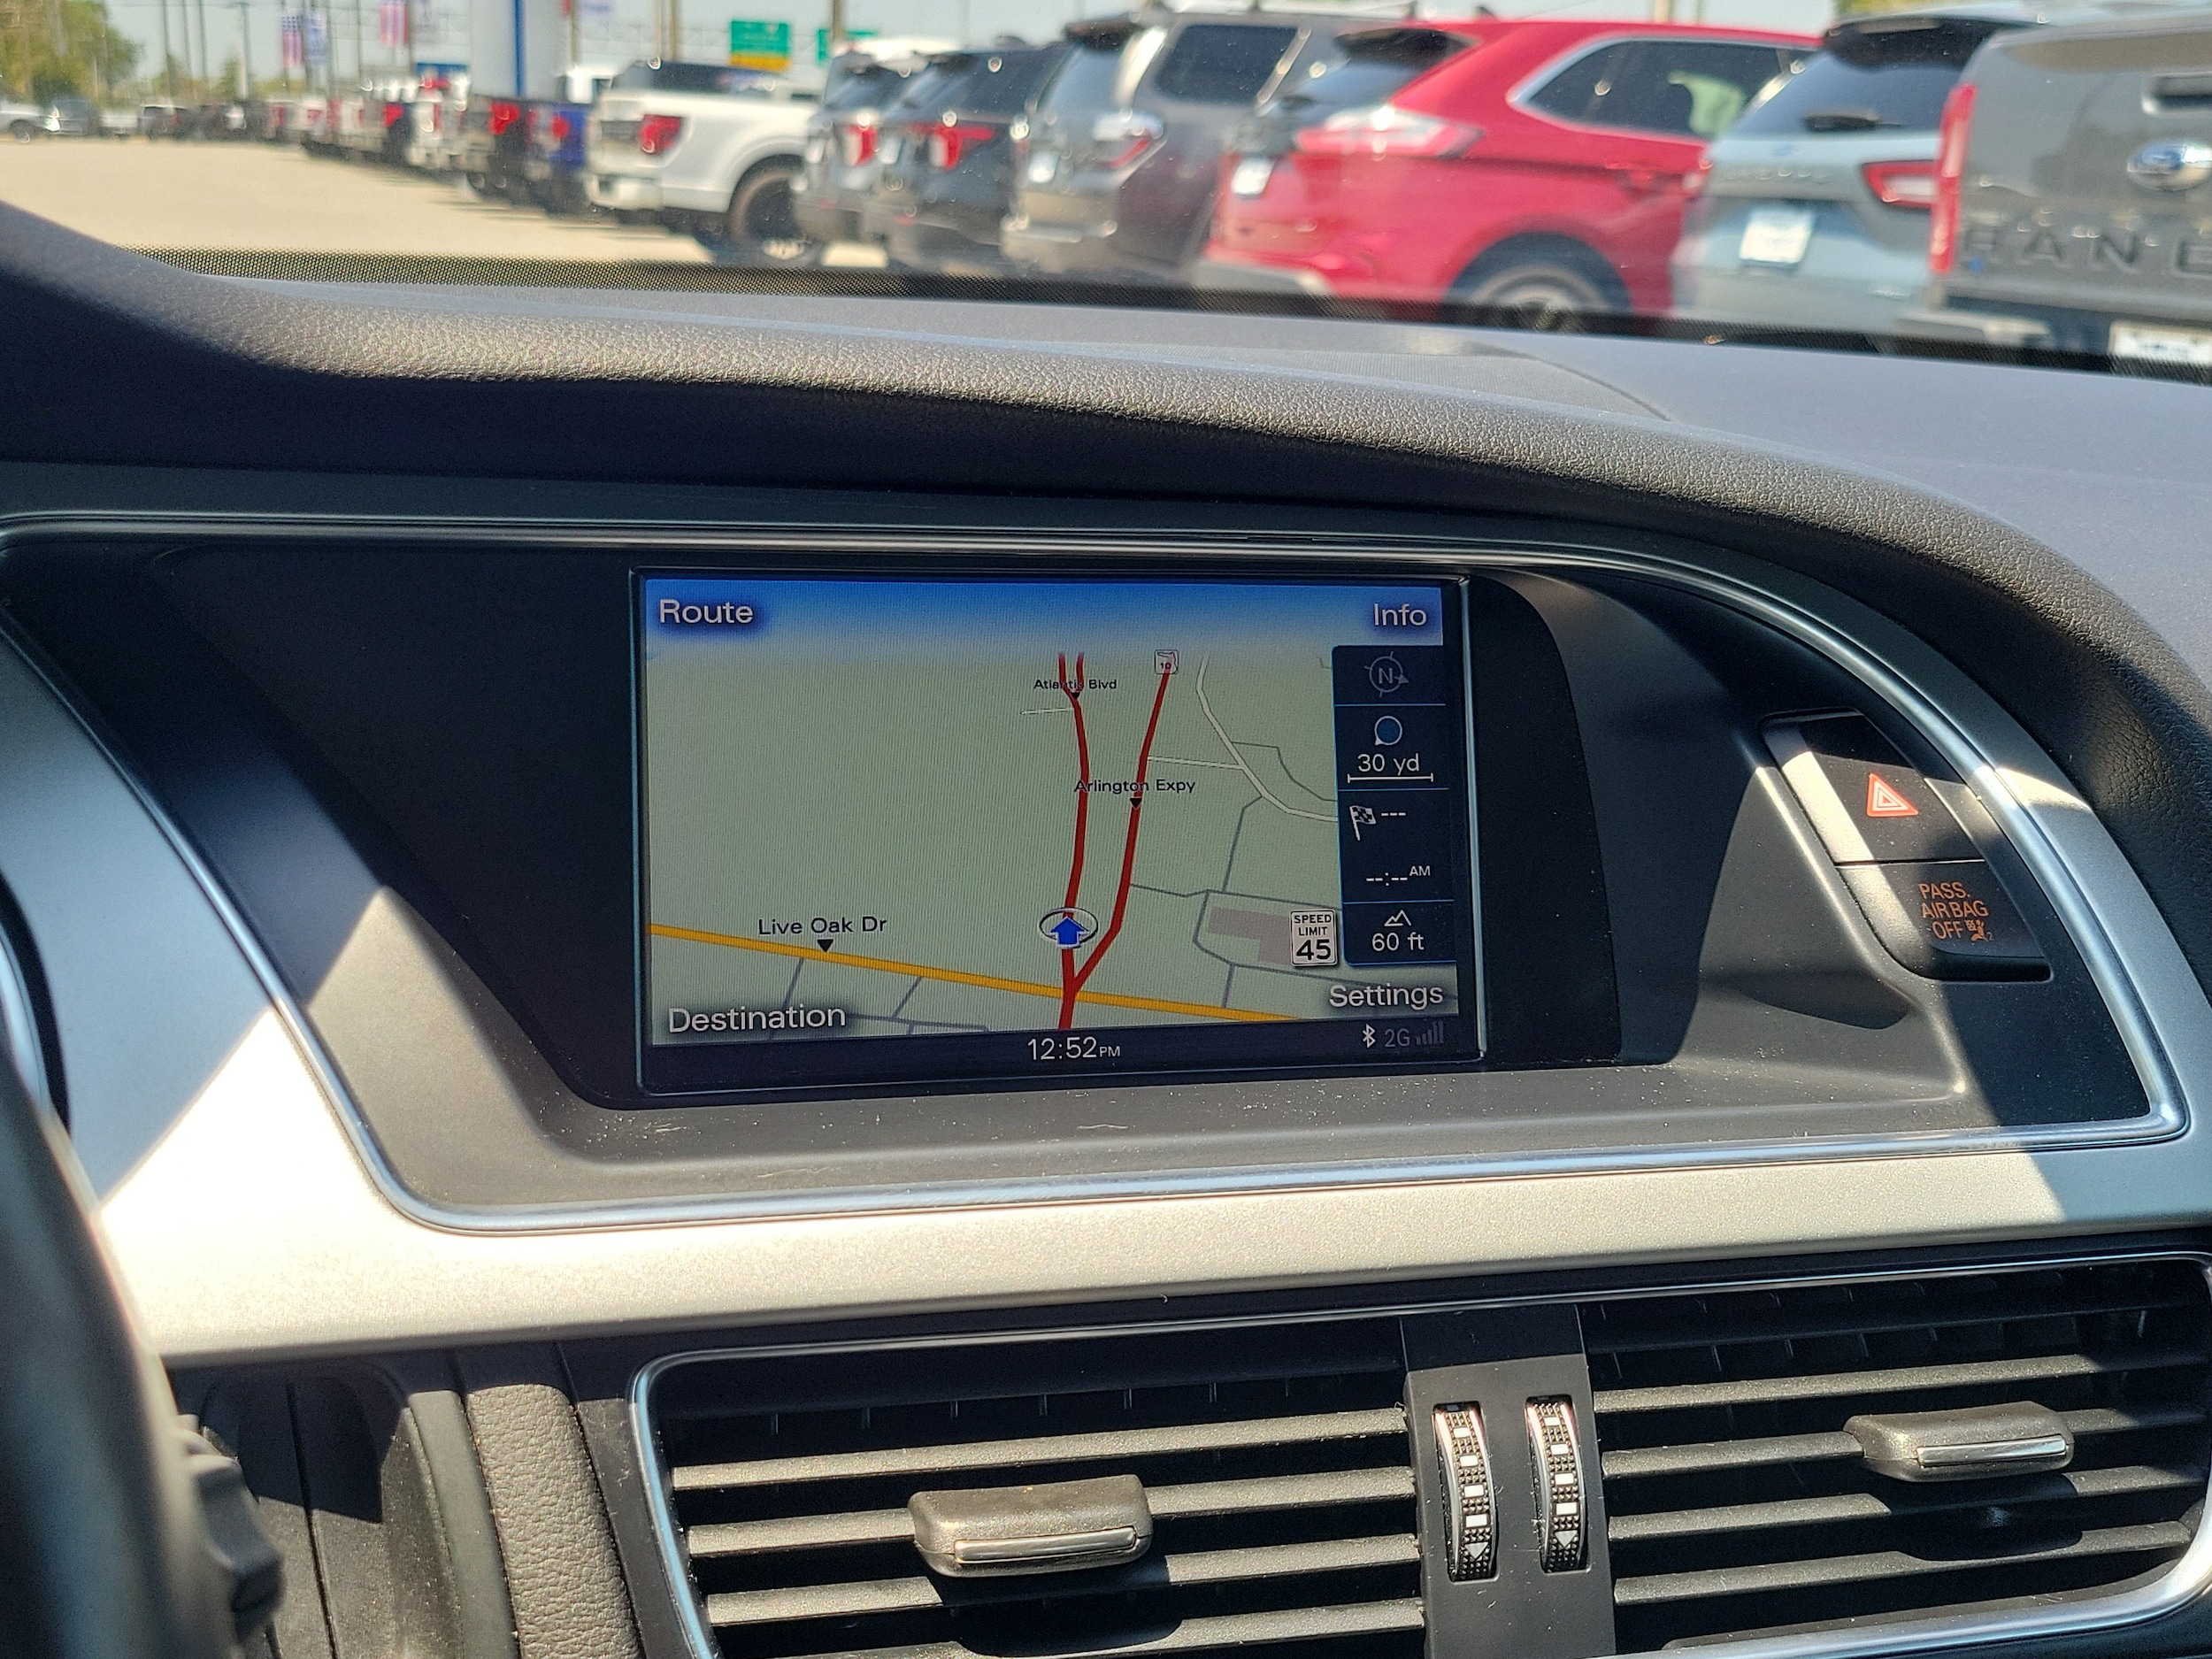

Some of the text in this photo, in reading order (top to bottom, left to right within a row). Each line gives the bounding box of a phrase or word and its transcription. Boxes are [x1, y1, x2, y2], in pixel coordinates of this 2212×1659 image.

[658, 598, 755, 625] Route
[1373, 603, 1427, 626] Info
[1033, 679, 1118, 689] Atlantic Blvd
[1378, 667, 1394, 684] N
[1356, 753, 1420, 776] 30 yd
[1073, 779, 1196, 795] Arlington Expy
[1409, 864, 1431, 877] AM
[1918, 881, 1971, 900] PASS.
[757, 915, 887, 935] Live Oak Dr
[1294, 914, 1332, 925] SPEED
[1298, 926, 1328, 937] LIMIT
[1932, 921, 1963, 940] OFF
[1295, 939, 1332, 961] 45
[1371, 931, 1425, 952] 60 ft
[1329, 982, 1444, 1010] Settings
[668, 1005, 847, 1033] Destination
[1384, 1028, 1410, 1048] 2G
